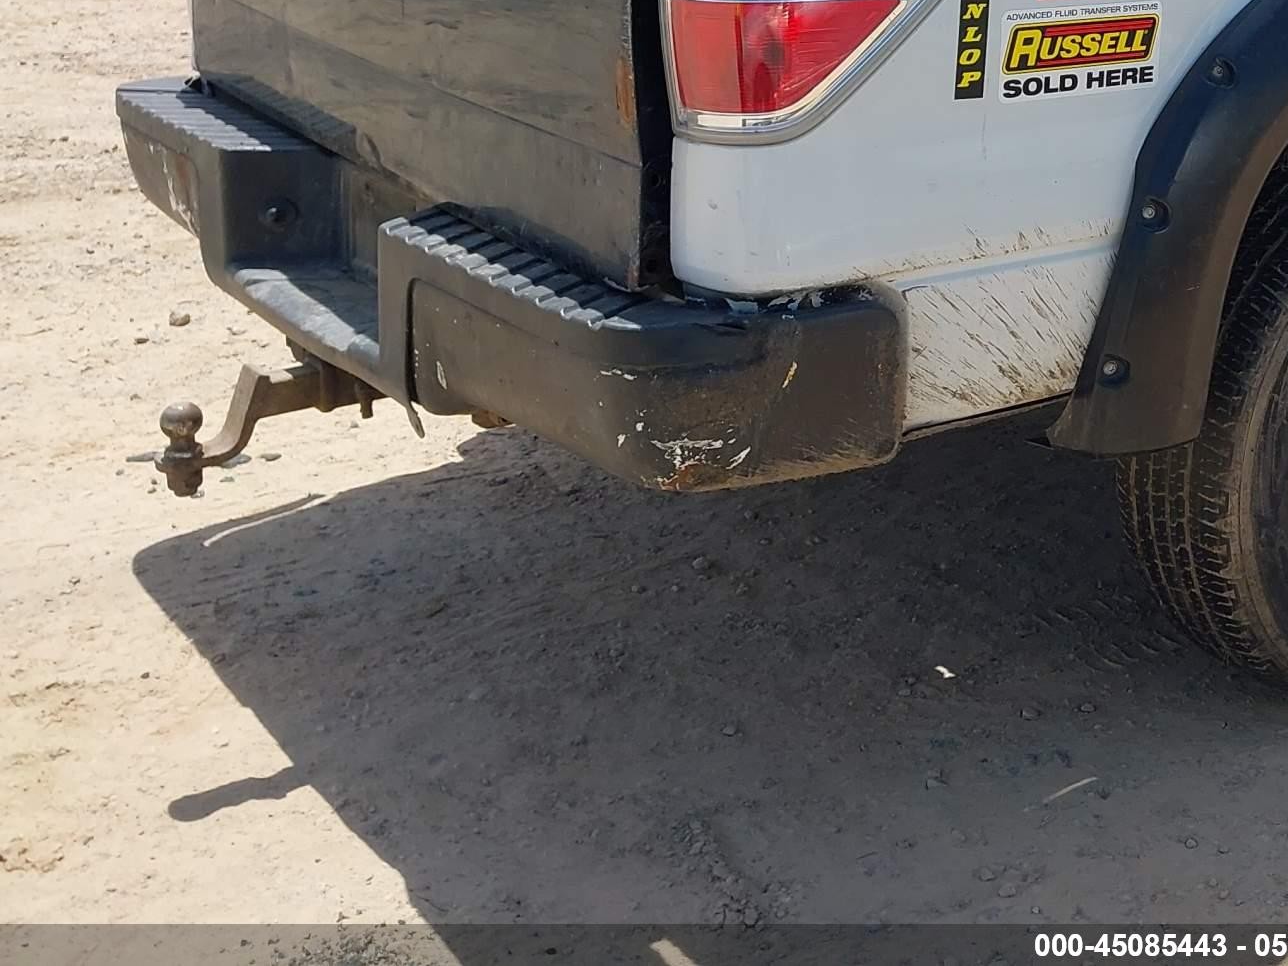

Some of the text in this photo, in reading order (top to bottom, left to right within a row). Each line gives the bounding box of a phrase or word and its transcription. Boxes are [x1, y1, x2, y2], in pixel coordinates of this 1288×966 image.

[1006, 2, 1159, 21] ADVANCED FLUID TRANSFER SYSTEMS
[1009, 29, 1149, 68] RUSSELL
[1002, 65, 1155, 99] SOLD HERE
